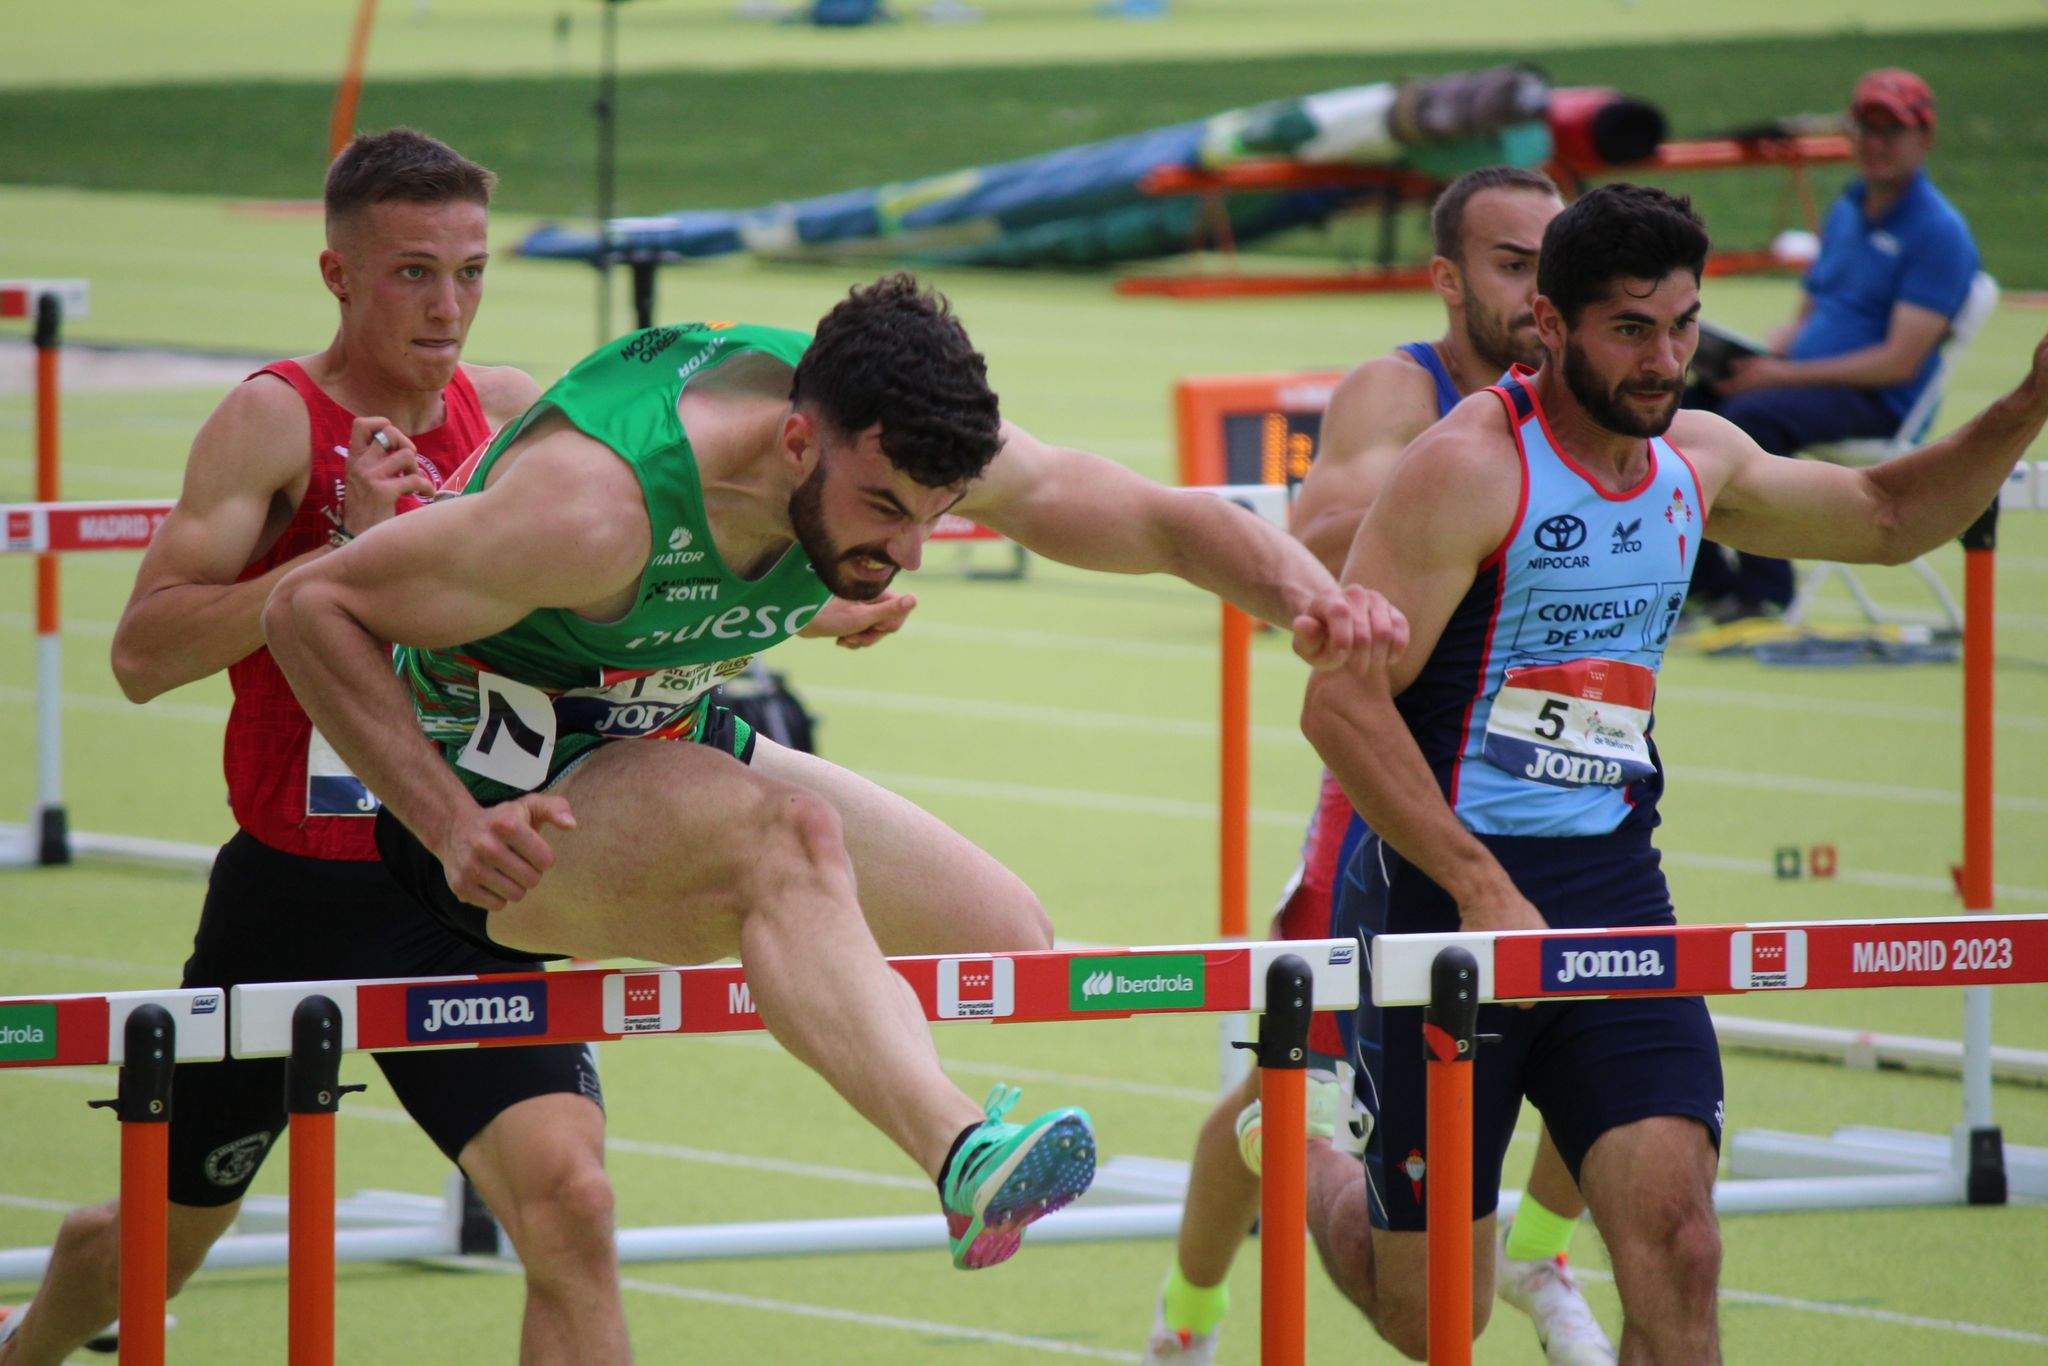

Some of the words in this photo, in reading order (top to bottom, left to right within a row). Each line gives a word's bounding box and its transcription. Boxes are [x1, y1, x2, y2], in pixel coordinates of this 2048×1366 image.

[1527, 555, 1590, 570] NIPOCAR
[665, 584, 719, 602] ZOITI
[1538, 598, 1648, 623] CONCELLO
[1544, 629, 1577, 646] DE
[476, 689, 545, 759] 7
[1535, 699, 1569, 741] 5
[1853, 940, 1947, 973] MADRID
[1952, 938, 2013, 970] 2023
[1116, 975, 1193, 993] Iberdrola
[624, 1016, 661, 1024] Comunidad
[635, 1023, 661, 1031] Madrid
